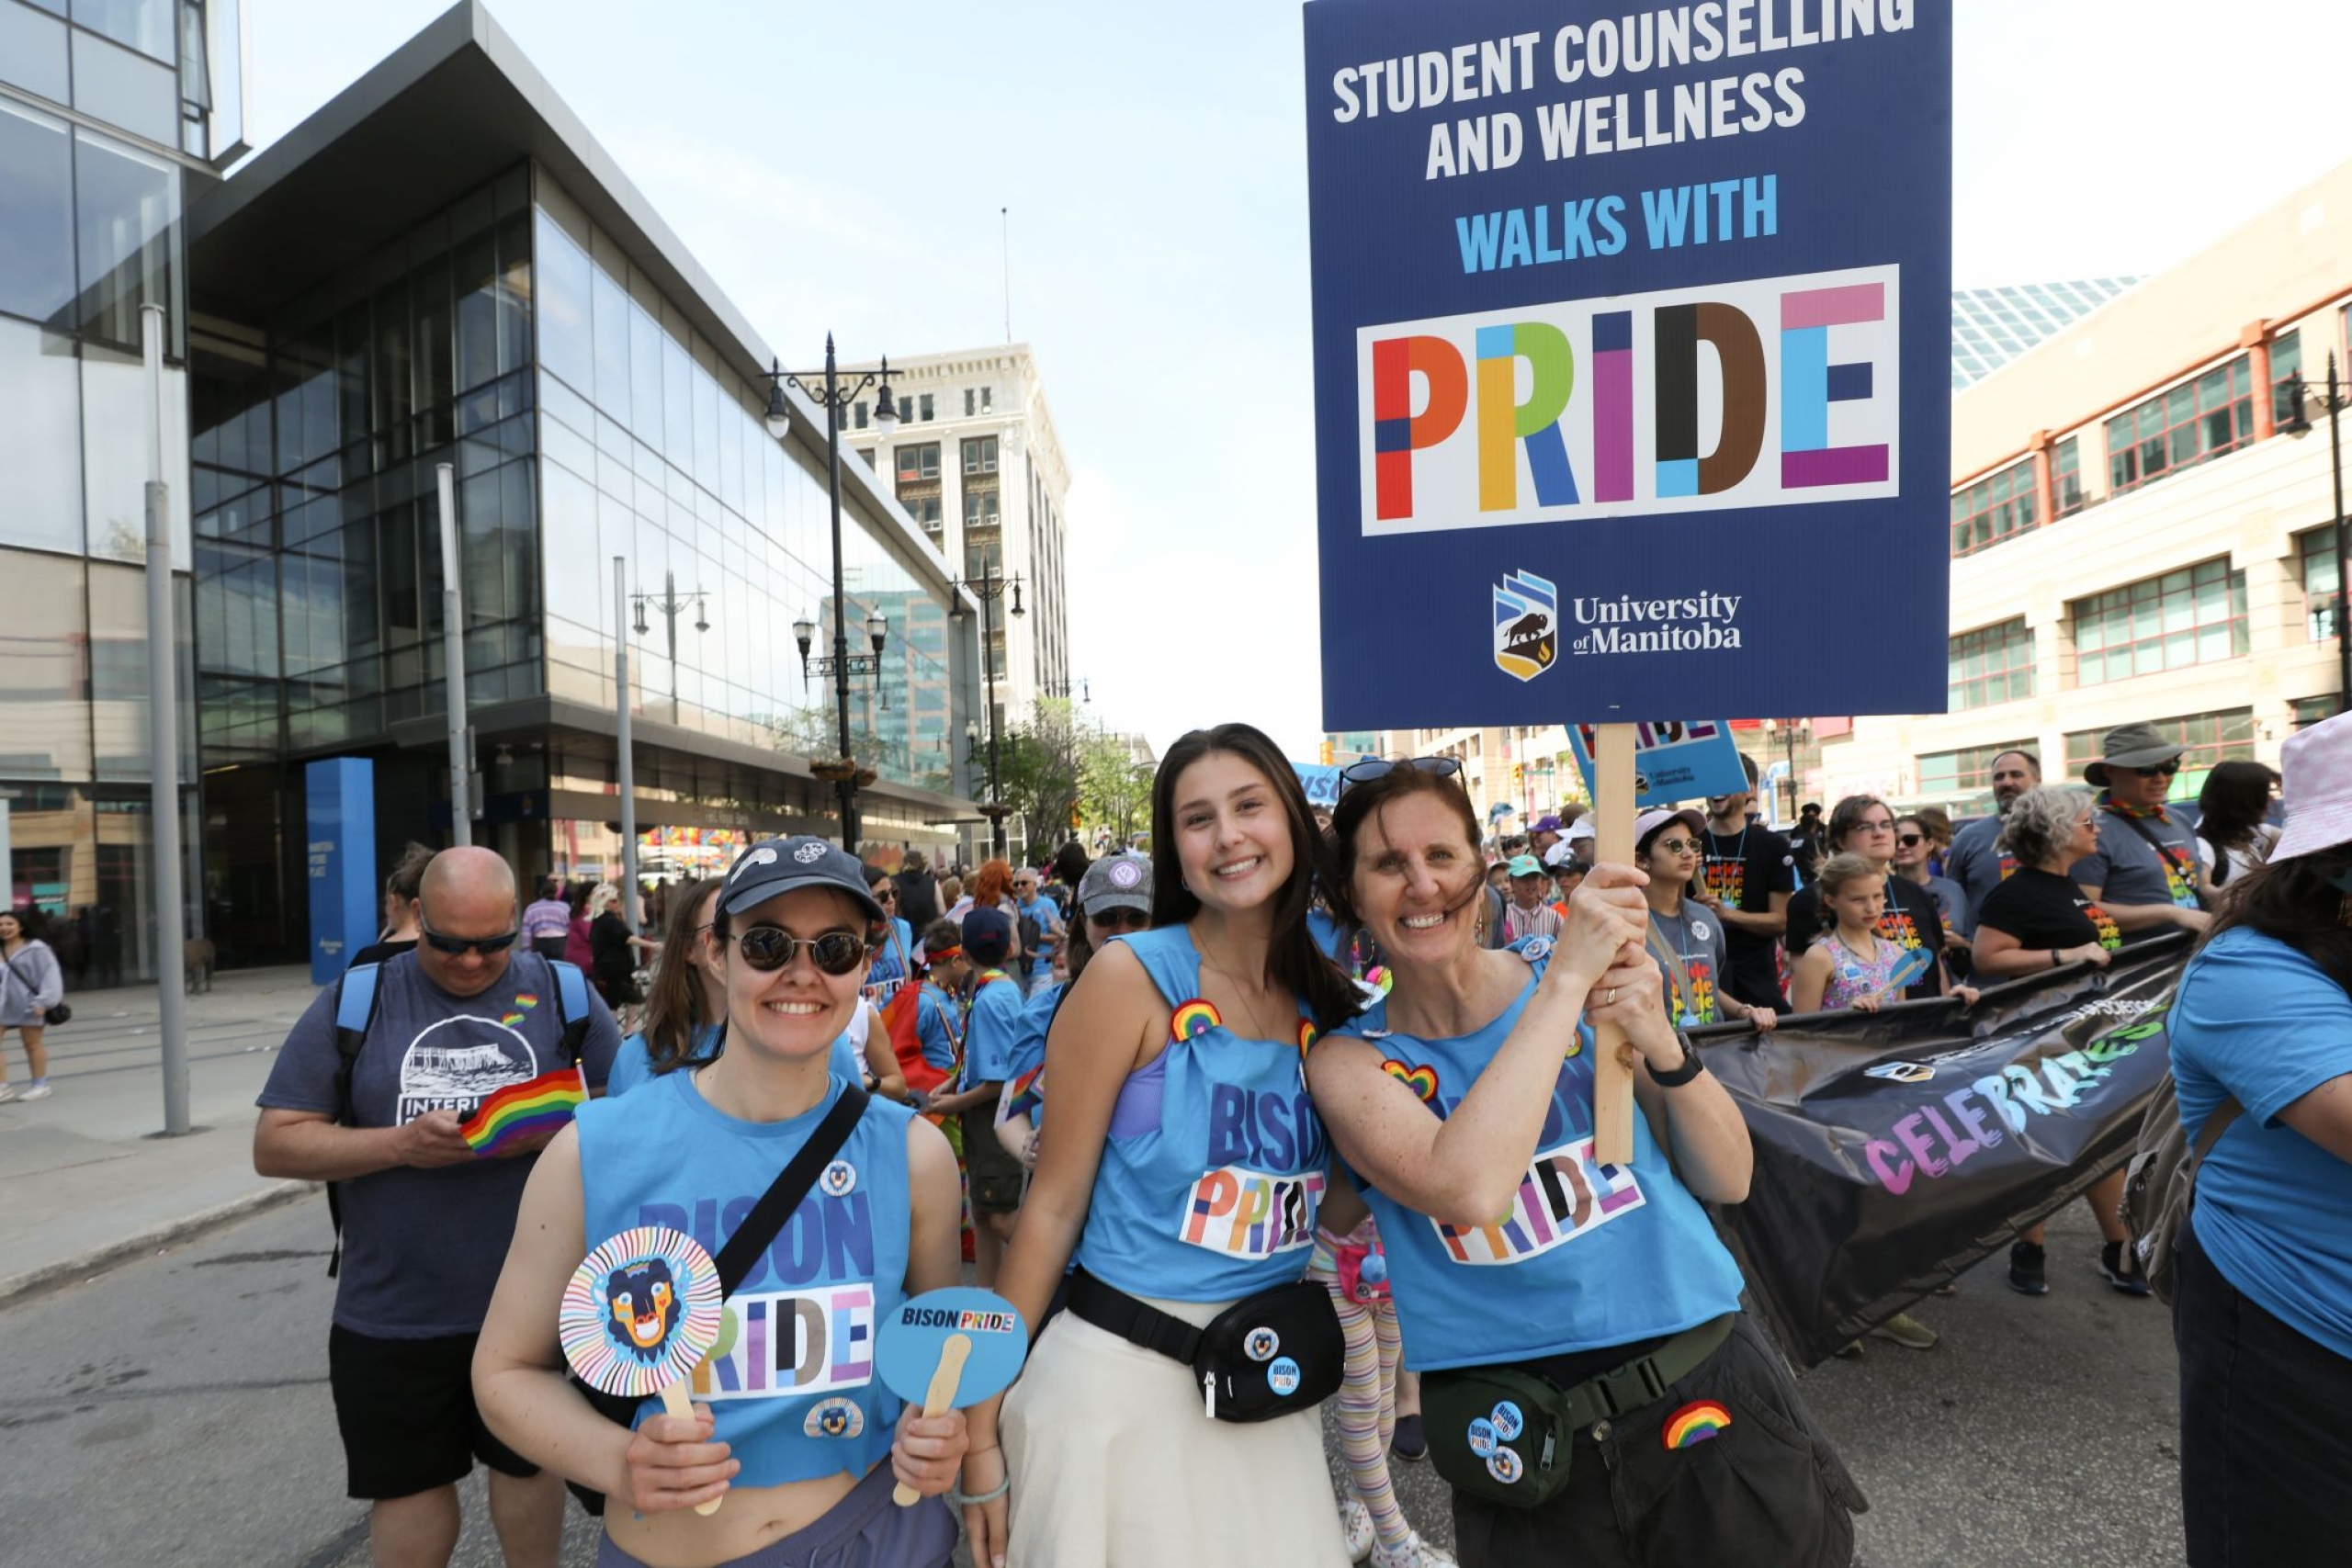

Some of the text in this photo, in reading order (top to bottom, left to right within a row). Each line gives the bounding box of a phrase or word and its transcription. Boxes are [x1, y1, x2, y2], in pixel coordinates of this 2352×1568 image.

[1333, 33, 1540, 123] STUDENT
[1425, 67, 1805, 180] AND WELLNESS
[1455, 175, 1777, 274] WALKS WITH
[1373, 282, 1888, 521] PRIDE
[1573, 591, 1742, 624] University
[1573, 622, 1742, 655] of Manitoba
[901, 1307, 1014, 1332] BISON PRIDE
[692, 1290, 872, 1394] RIDE
[1272, 1364, 1297, 1376] BISON
[1273, 1376, 1296, 1387] PRIDE
[1470, 1424, 1491, 1439] BISON
[1497, 1404, 1519, 1430] BISON
